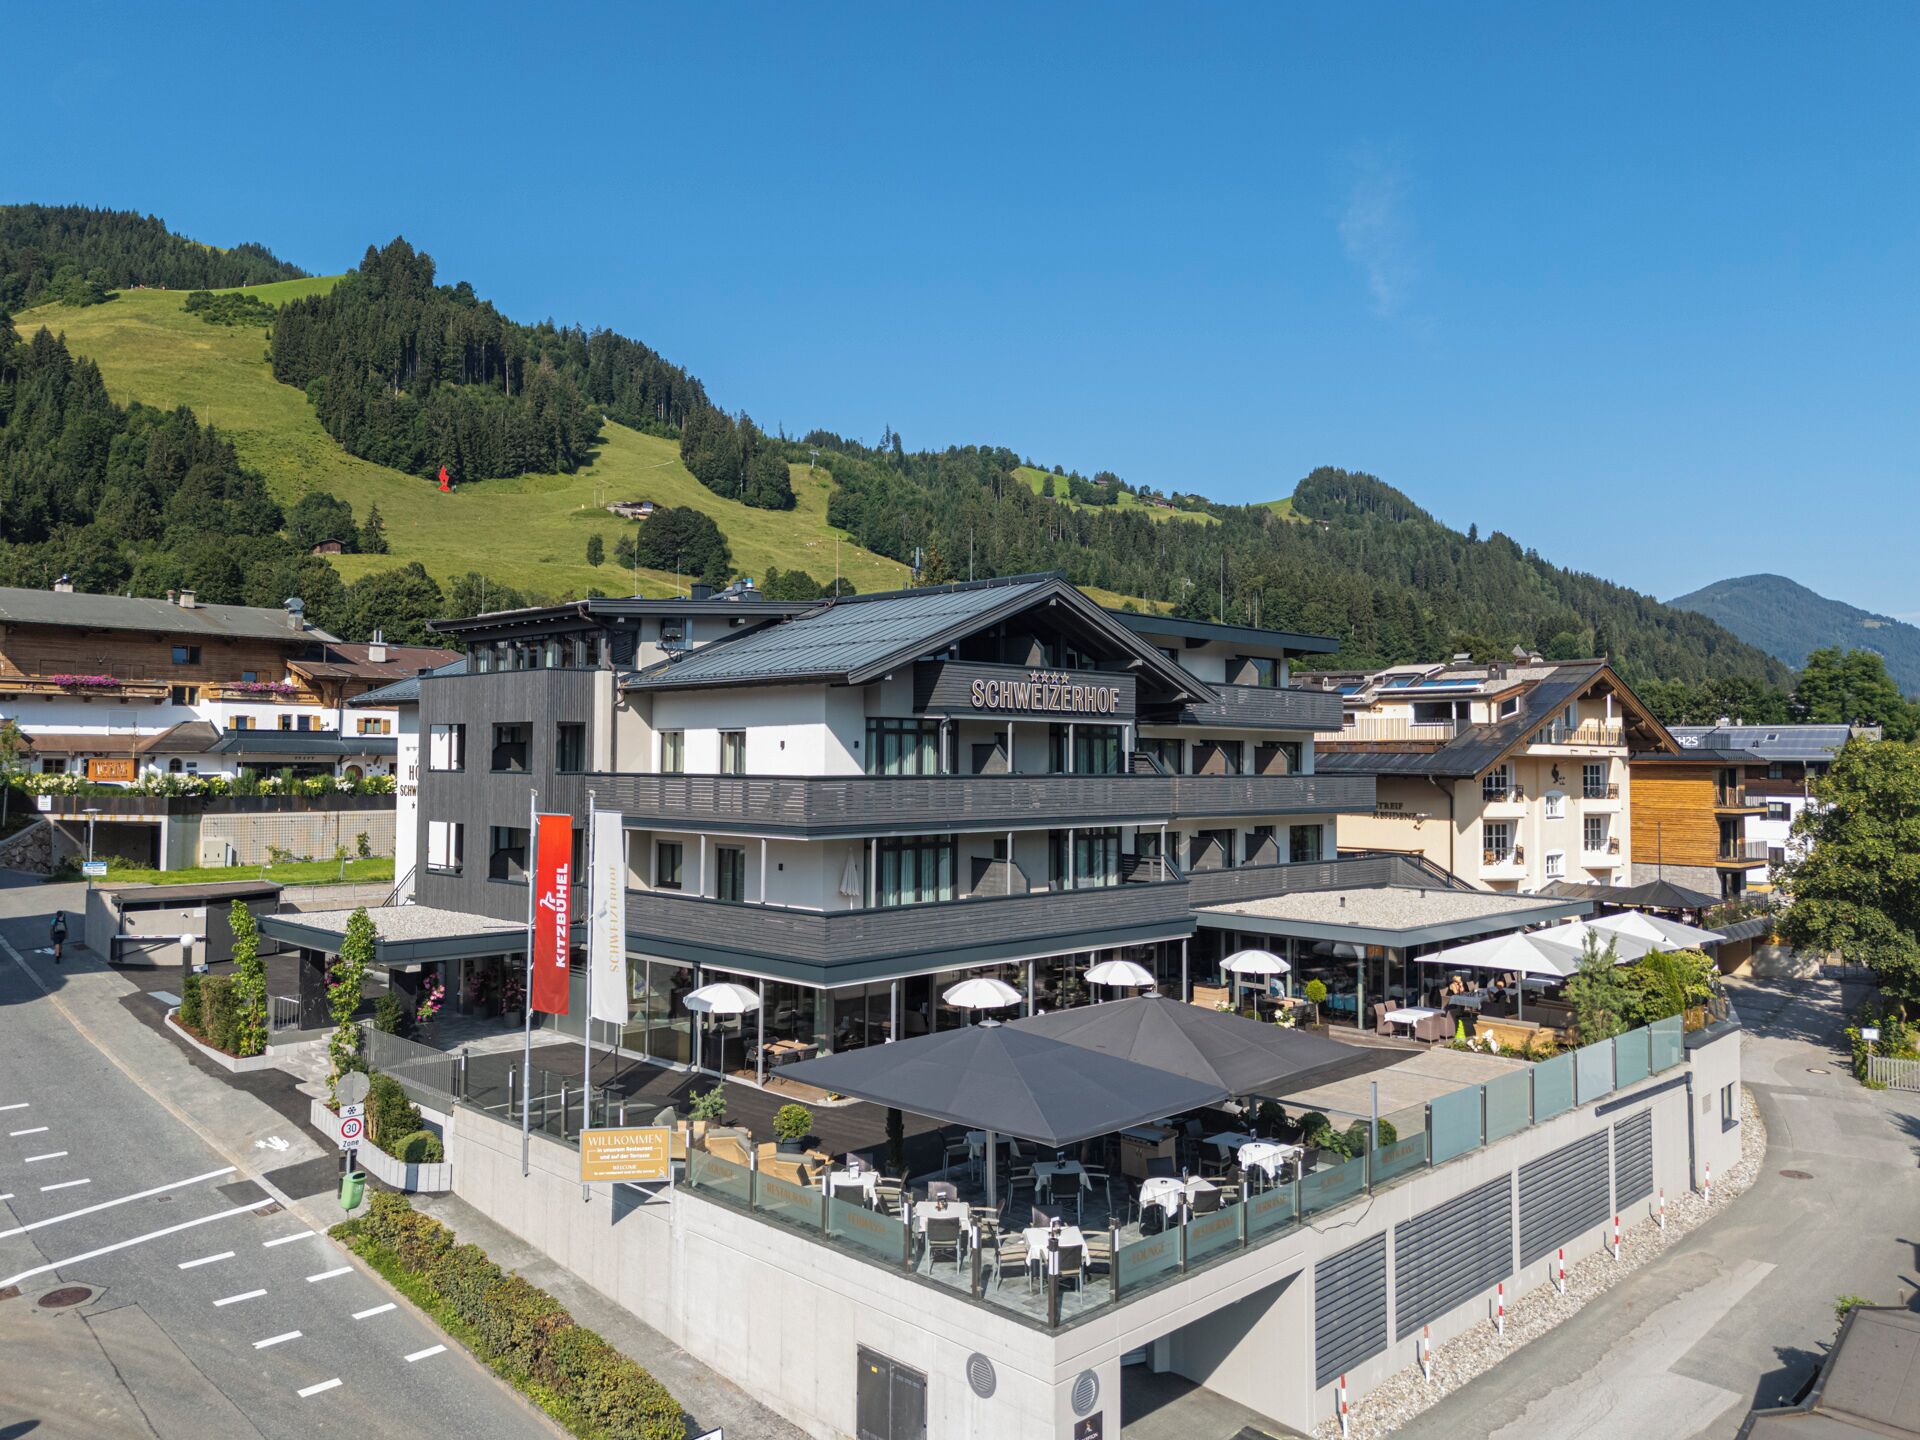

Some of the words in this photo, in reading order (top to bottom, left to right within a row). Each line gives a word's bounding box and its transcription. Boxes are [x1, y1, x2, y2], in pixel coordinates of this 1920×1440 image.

[972, 679, 1120, 713] SCHWEIZERHOF
[1678, 736, 1698, 746] H2S
[346, 1123, 357, 1134] 30
[343, 1140, 360, 1148] Zone
[588, 1134, 663, 1146] WILLKOMMEN
